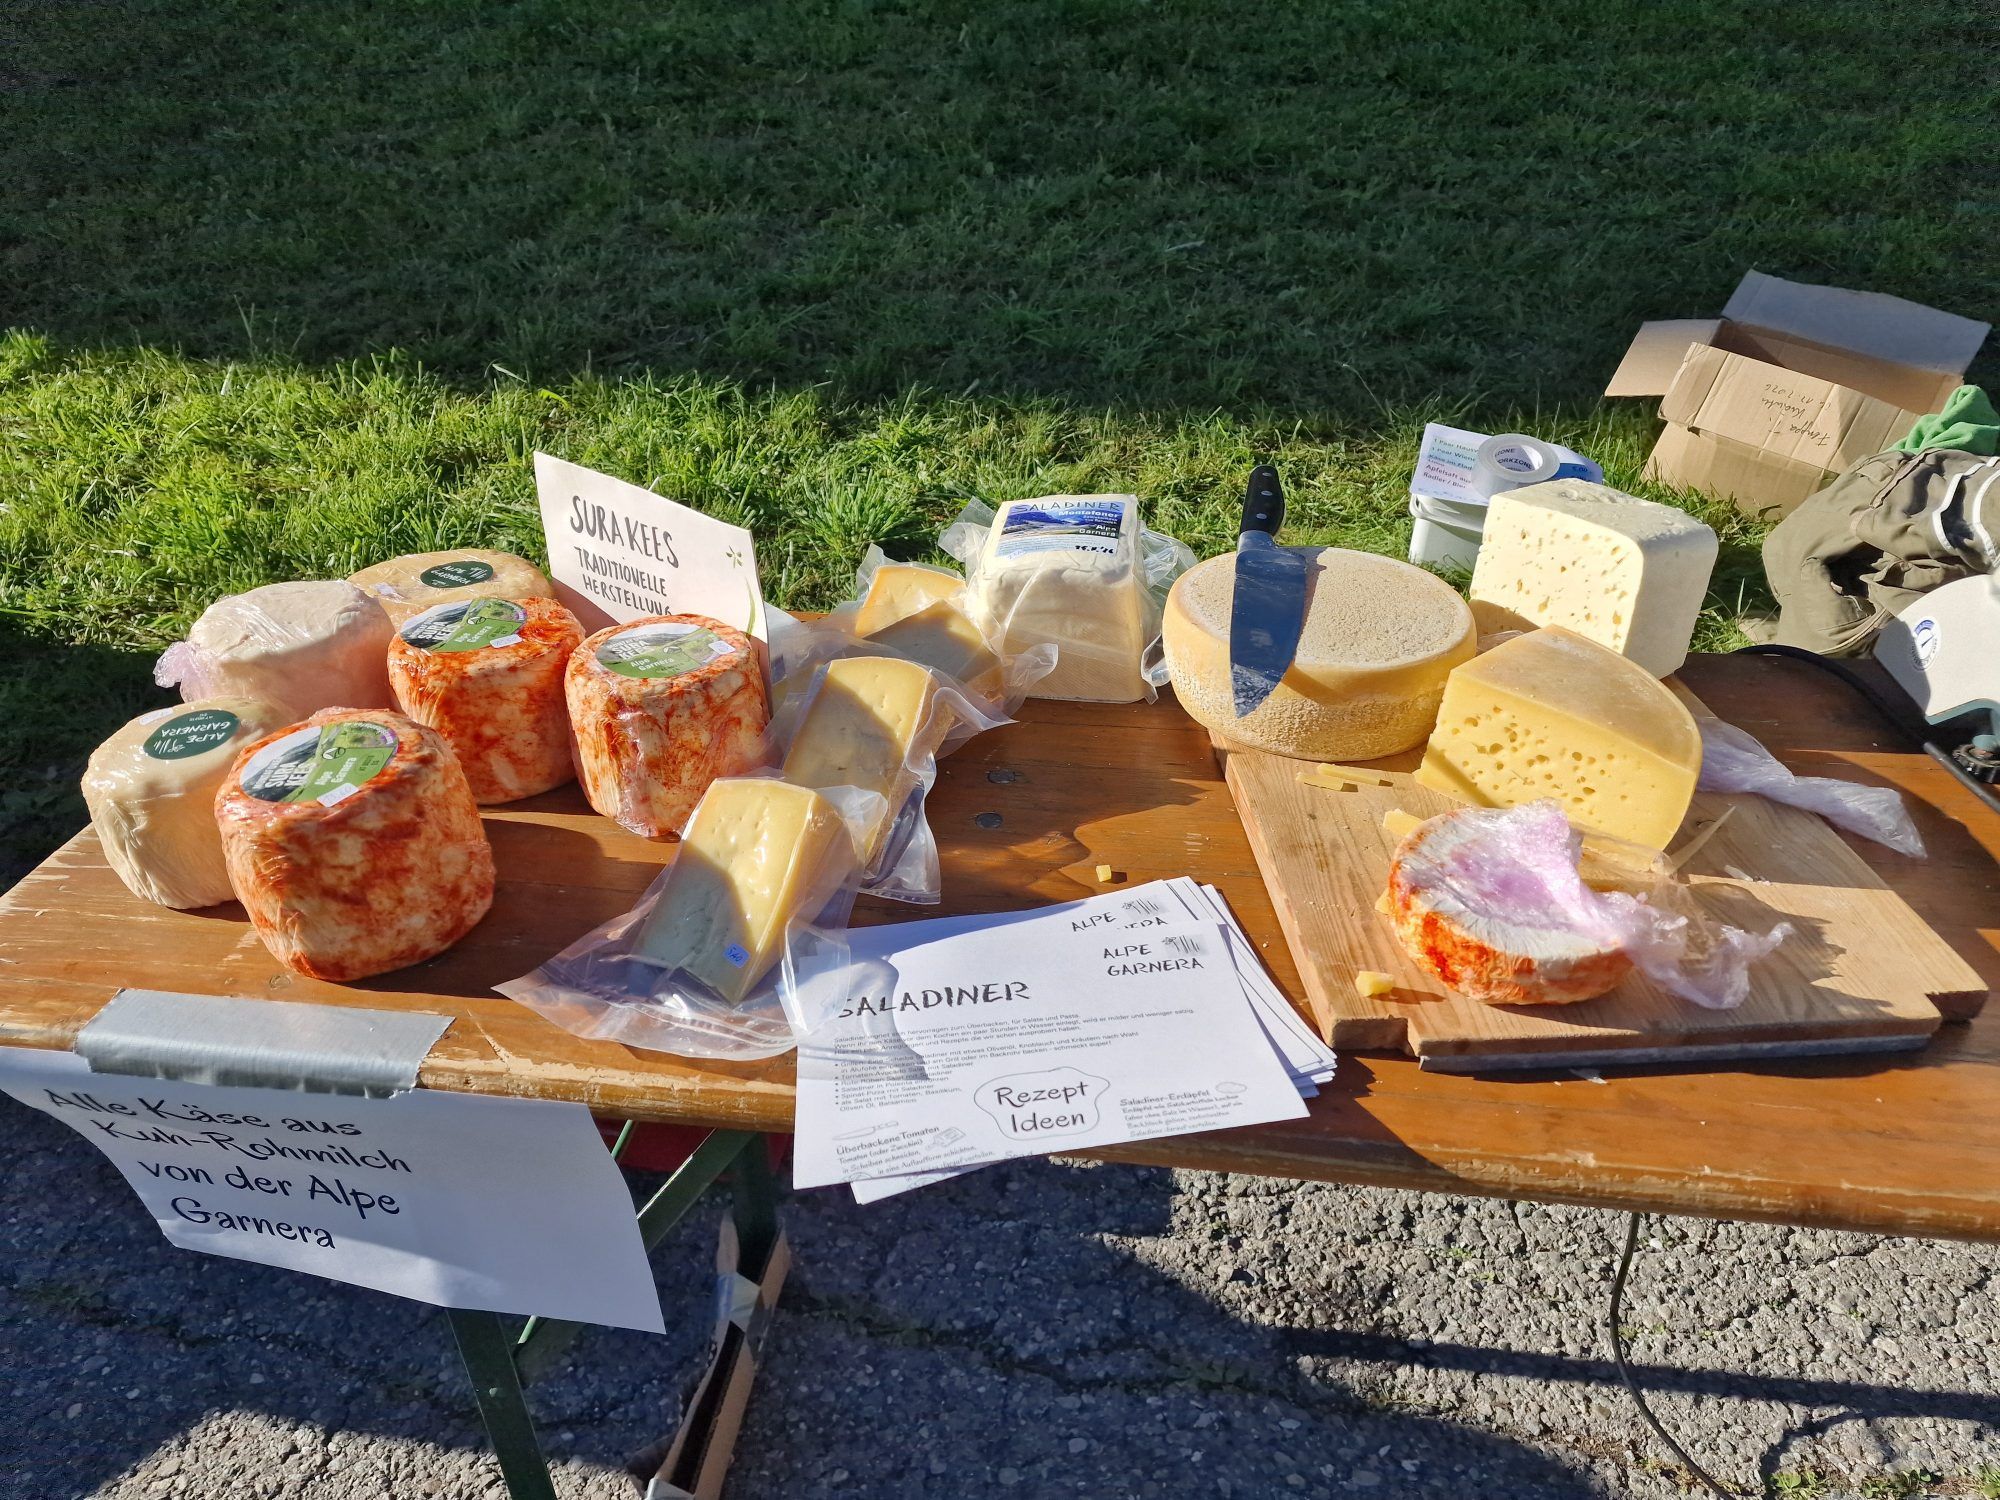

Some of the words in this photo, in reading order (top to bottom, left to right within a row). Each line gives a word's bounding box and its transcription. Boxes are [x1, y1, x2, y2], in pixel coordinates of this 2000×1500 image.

[1497, 458, 1532, 470] ORKZONE
[1423, 472, 1446, 483] Radler
[1014, 500, 1122, 513] SALADINER
[1080, 528, 1116, 537] Garnera
[574, 546, 667, 597] TRADITIONELLE
[612, 640, 650, 654] SURA
[630, 658, 650, 667] Alpe
[638, 658, 674, 670] Garnera
[161, 721, 231, 737] GARNERA
[186, 732, 226, 744] ALPE
[1071, 911, 1117, 932] ALPE
[1103, 944, 1152, 959] ALPE
[1107, 957, 1204, 977] GARNERA
[994, 1081, 1089, 1108] Rezept
[1120, 1090, 1210, 1106] Saladiner-Erdäpfel
[44, 1088, 137, 1118] Alle
[138, 1097, 270, 1128] Käse
[281, 1116, 364, 1137] aus
[1011, 1112, 1085, 1133] Ideen
[98, 1120, 412, 1174] Kuh-Rohmilch
[836, 1136, 900, 1155] Überbackene
[900, 1126, 940, 1139] Tomaten
[138, 1159, 214, 1186] von
[224, 1166, 293, 1198] der
[309, 1174, 400, 1221] Alpe
[171, 1197, 336, 1251] Garnera
